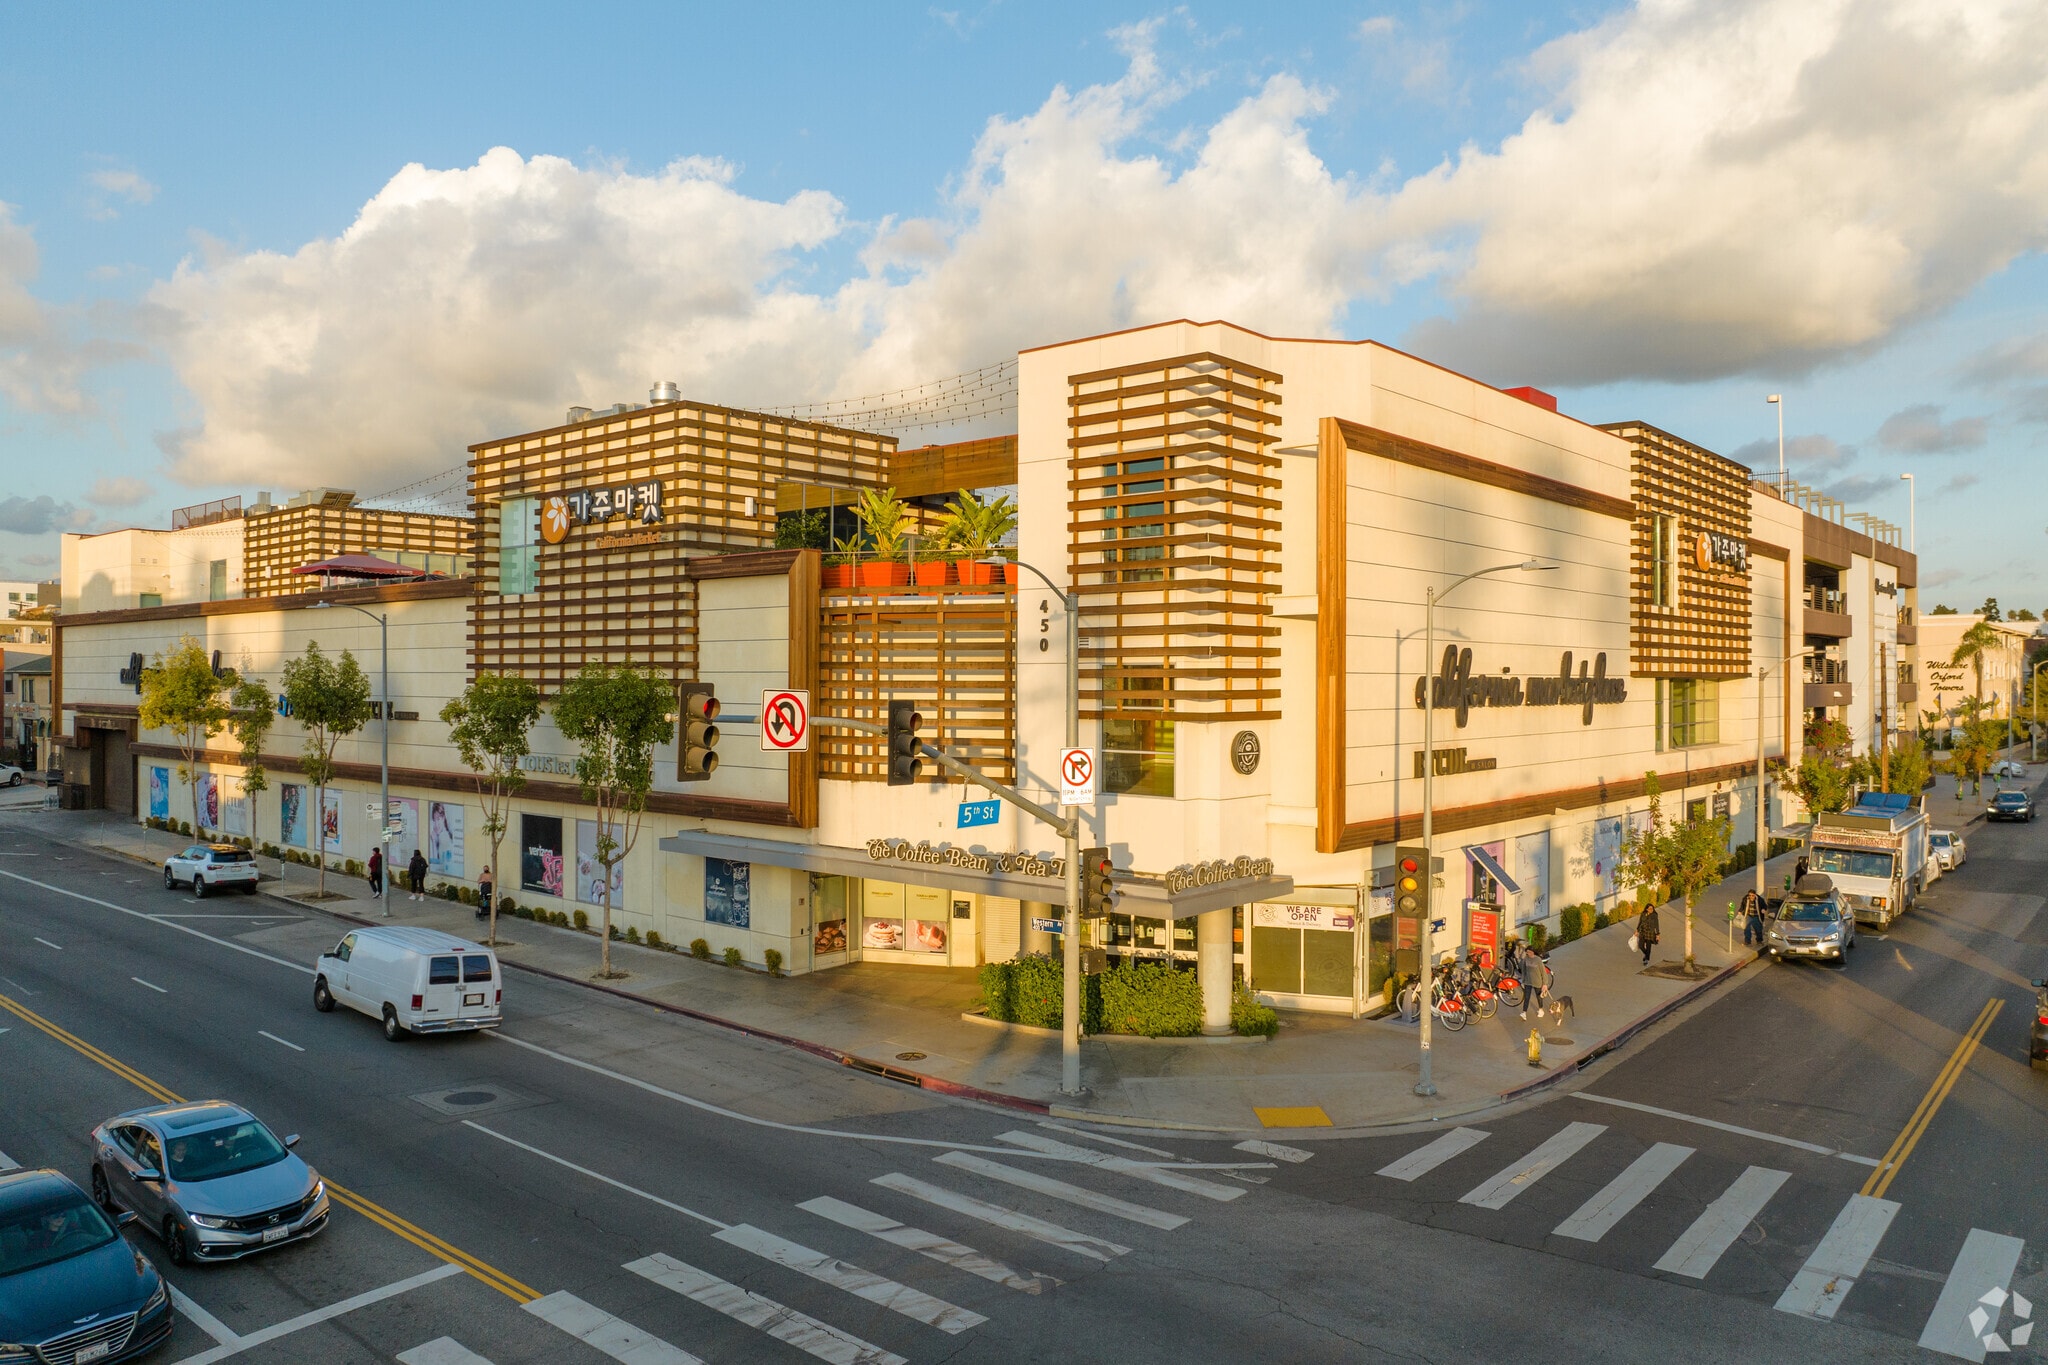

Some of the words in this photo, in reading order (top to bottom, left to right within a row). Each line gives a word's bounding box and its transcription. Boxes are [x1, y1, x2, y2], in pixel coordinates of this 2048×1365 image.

[568, 481, 662, 523] 가주마켓
[595, 534, 632, 549] California
[633, 531, 661, 546] Market
[1711, 535, 1746, 569] 가주마켓
[1039, 599, 1049, 652] 450
[1930, 671, 1964, 682] Oxford
[1930, 682, 1964, 691] Towers
[963, 806, 980, 824] 5th
[982, 806, 994, 820] St
[866, 839, 891, 861] The
[894, 842, 941, 865] Coffee
[995, 854, 1010, 873] &
[1015, 855, 1047, 877] Tea
[1169, 870, 1194, 895] The
[1196, 861, 1236, 887] Coffee
[1239, 858, 1273, 878] Bean
[1286, 906, 1301, 914] WE
[1304, 907, 1322, 915] ARE
[1291, 913, 1317, 922] OPEN
[1032, 917, 1054, 928] Western
